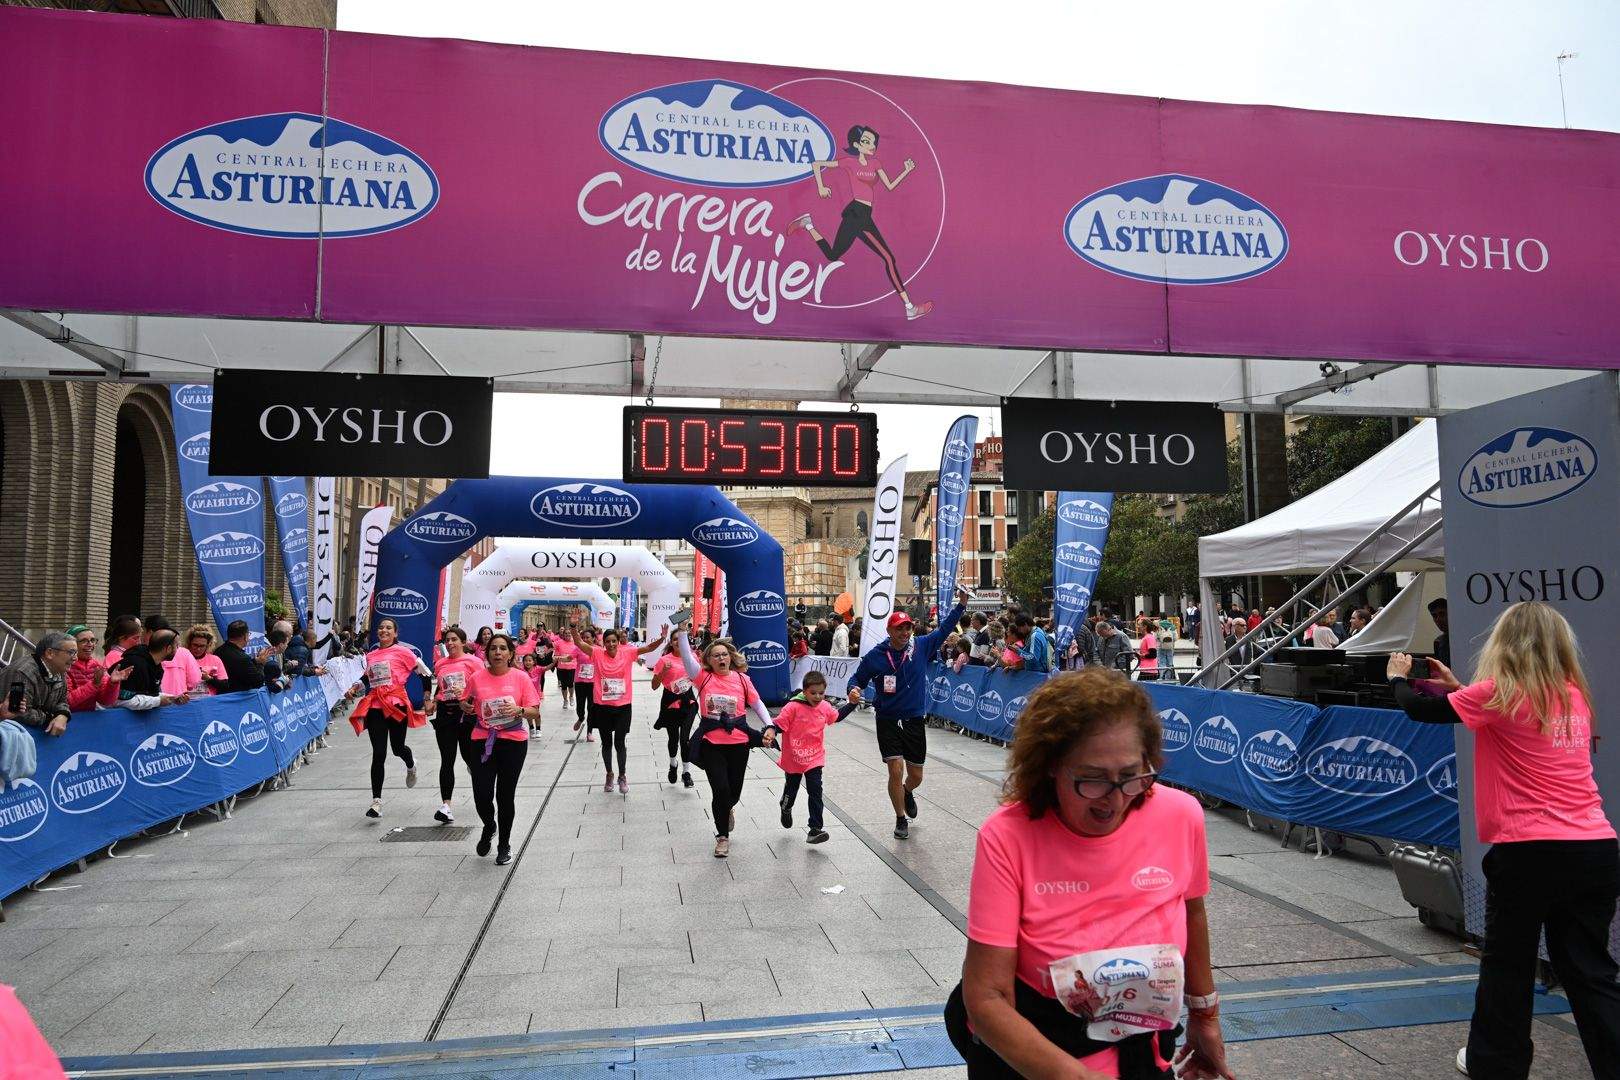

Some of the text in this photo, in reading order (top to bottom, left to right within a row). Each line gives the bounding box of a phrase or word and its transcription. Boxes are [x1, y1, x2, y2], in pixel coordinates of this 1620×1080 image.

[654, 111, 811, 134] CENTRAL LECHERA
[617, 111, 817, 165] ASTURIANA
[215, 152, 410, 175] CENTRAL LECHERA
[166, 152, 418, 211] ASTURIANA
[577, 171, 775, 238] Carrera
[1116, 208, 1265, 228] CENTRAL LECHERA
[1082, 209, 1273, 260] ASTURIANA
[1393, 229, 1550, 275] OYSHO
[625, 232, 845, 325] de la Mujer
[258, 404, 454, 448] OYSHO
[1039, 430, 1196, 467] OYSHO
[1485, 444, 1580, 470] CENTRAL LECHERA
[1467, 456, 1586, 495] ASTURIANA
[539, 495, 633, 517] ASTURIANA
[409, 522, 471, 537] ASTURIANA
[698, 530, 754, 540] ASTURIANA
[531, 551, 617, 569] OYSHO
[867, 485, 899, 620] OYSHO
[1466, 566, 1605, 605] OYSHO
[738, 602, 783, 612] ASTURIANA
[204, 739, 238, 759] ASTURIANA
[137, 751, 193, 779] ASTURIANA
[1311, 755, 1407, 785] ASTURIANA
[57, 771, 123, 805] ASTURIANA
[1034, 880, 1090, 895] OYSHO
[1115, 1013, 1144, 1024] MUJER
